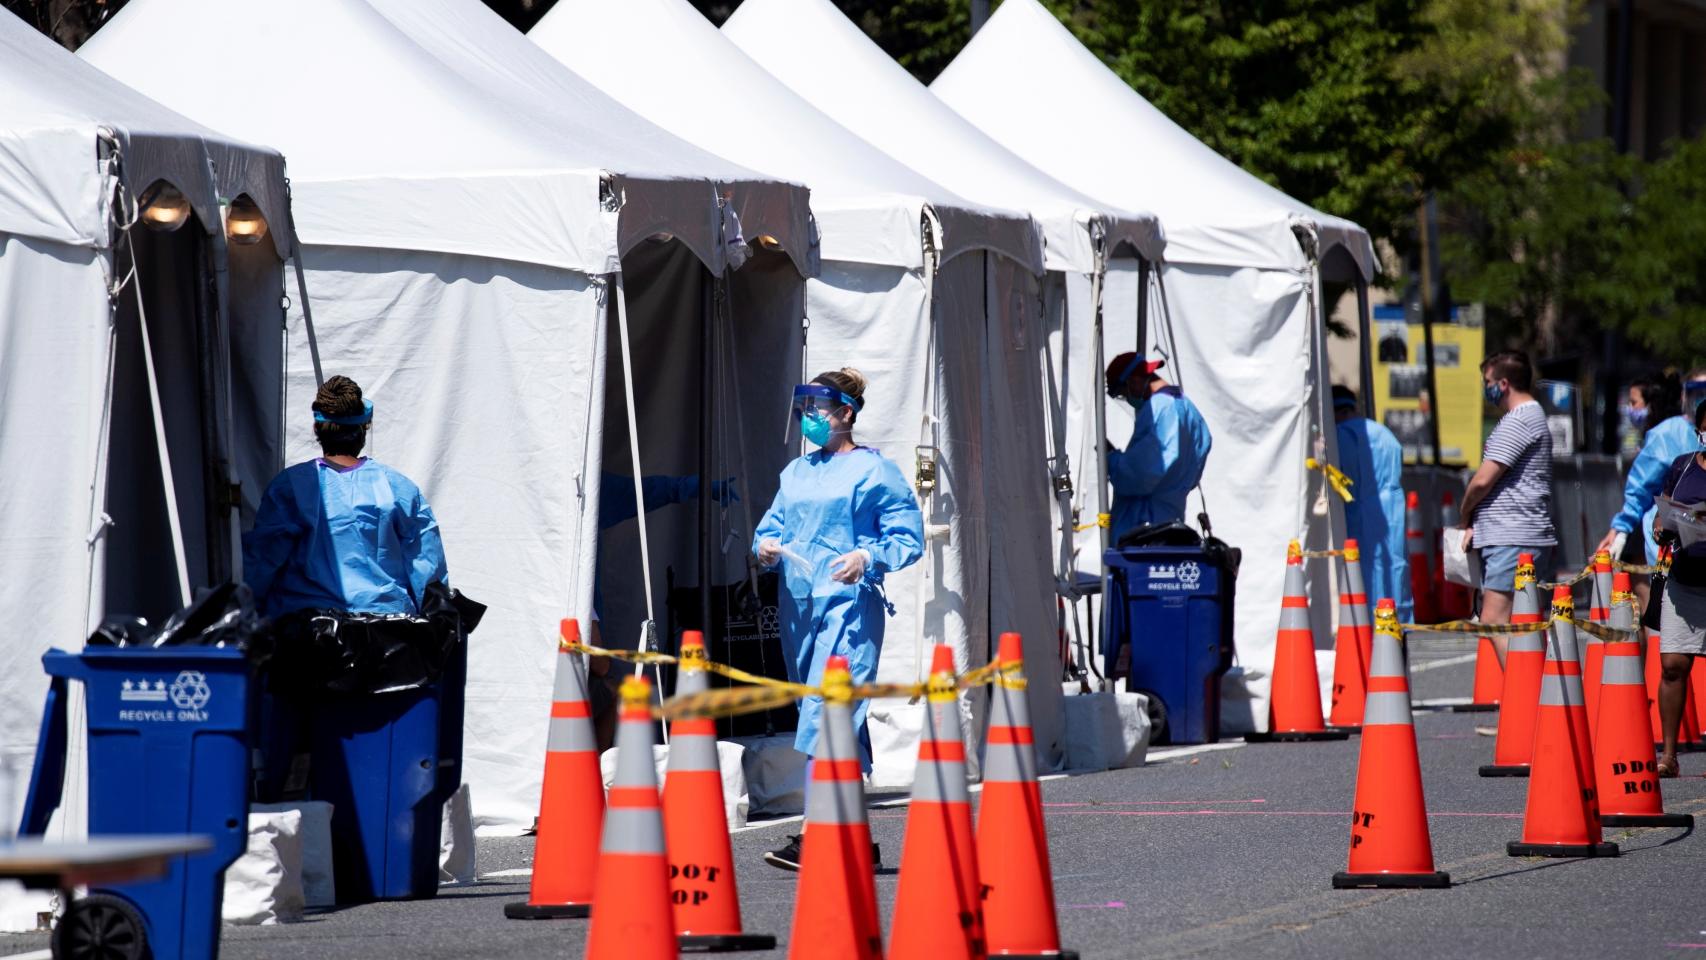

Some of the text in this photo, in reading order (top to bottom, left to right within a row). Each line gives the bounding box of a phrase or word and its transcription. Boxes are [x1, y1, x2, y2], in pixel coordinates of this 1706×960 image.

[1148, 582, 1200, 590] RECYCLE ONLY
[119, 709, 209, 721] RECYCLE ONLY
[1612, 760, 1657, 776] DDO
[668, 864, 720, 882] DOT
[671, 889, 709, 905] OP
